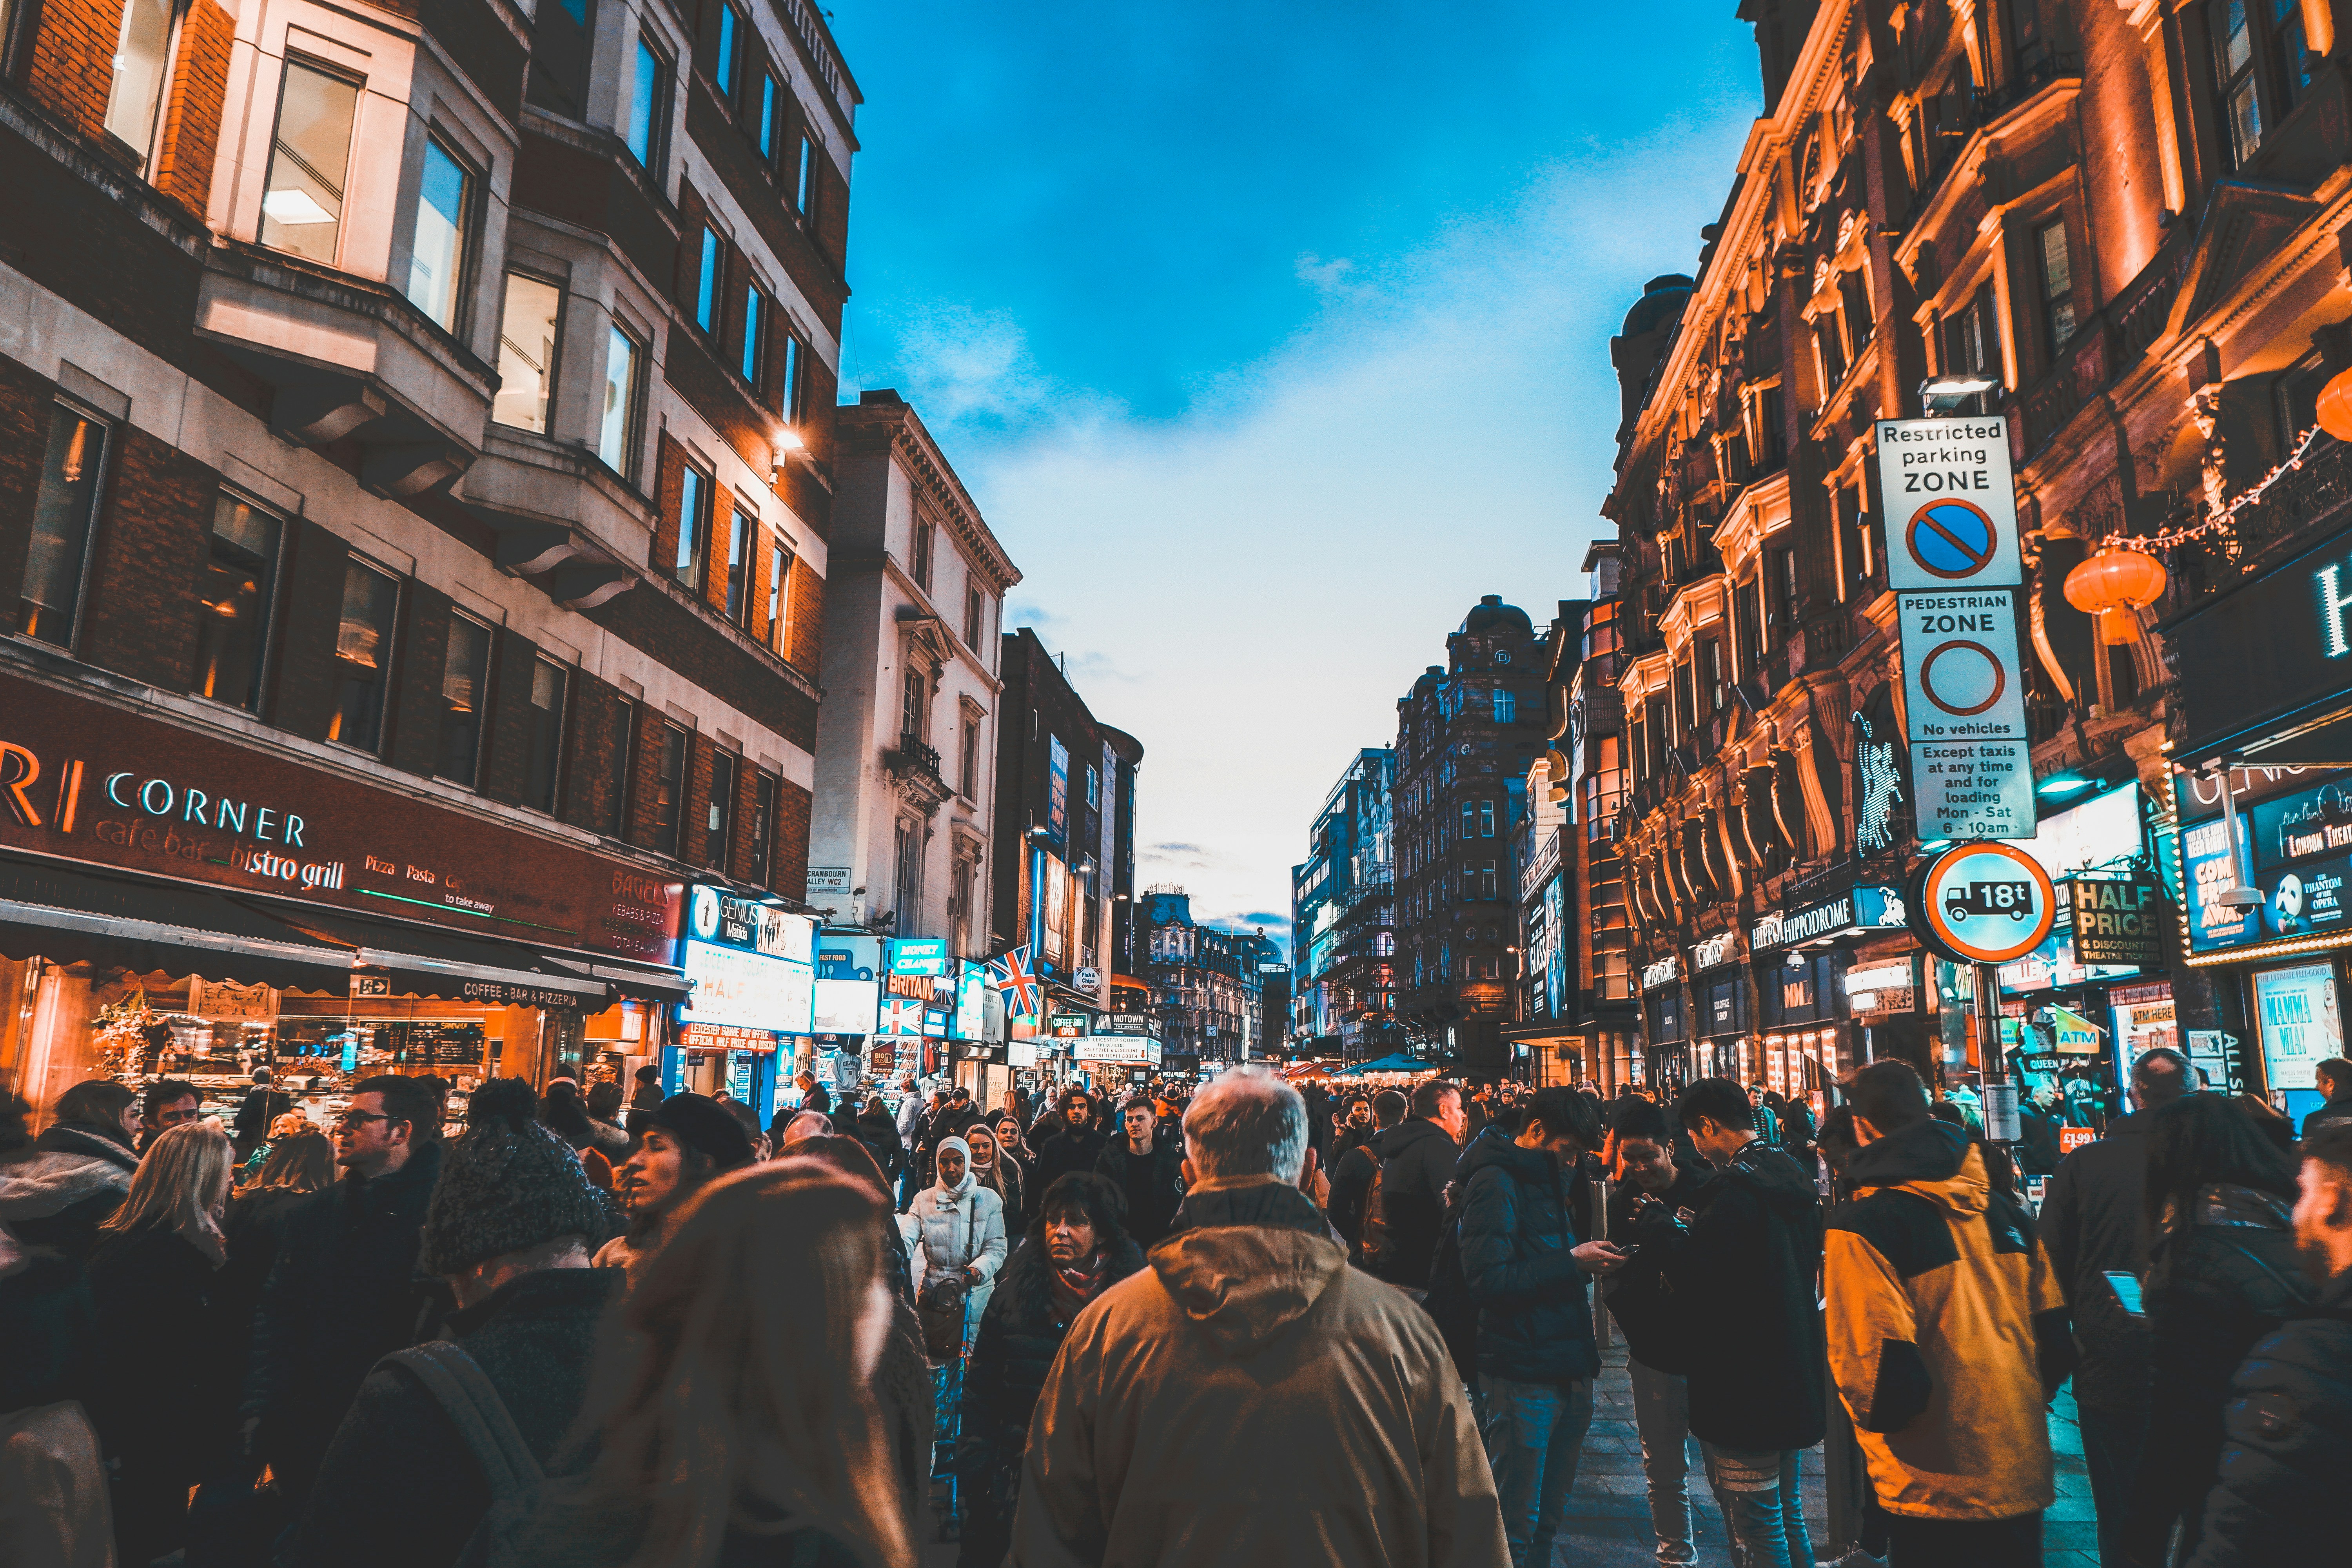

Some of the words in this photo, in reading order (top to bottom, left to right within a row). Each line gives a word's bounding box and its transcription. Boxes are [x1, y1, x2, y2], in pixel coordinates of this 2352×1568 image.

[1884, 422, 2001, 443] Restricted
[1903, 447, 1986, 467] parking
[1904, 470, 1989, 492] ZONE
[1906, 596, 2006, 610] PEDESTRIAN
[1922, 614, 1995, 633] ZONE
[1924, 724, 1947, 735] No
[1949, 723, 2011, 734] vehicles
[1924, 747, 1975, 760] Except
[1979, 746, 2016, 757] taxis
[1928, 763, 1943, 773] at
[1948, 764, 1974, 775] any
[1980, 761, 2013, 771] time
[1945, 777, 1971, 788] and
[1978, 776, 1999, 787] for
[1946, 791, 2000, 804] loading
[106, 772, 305, 848] CORNER
[1937, 807, 1968, 818] Mon
[1986, 806, 2011, 817] Sat
[1943, 822, 1953, 833] 6
[1970, 822, 2009, 833] 10am
[2288, 832, 2324, 857] LONDON
[231, 840, 297, 880] bistro
[300, 860, 345, 891] grill
[365, 855, 395, 875] Pizza
[407, 864, 435, 884] Pasta
[2196, 856, 2234, 884] COM
[613, 871, 670, 909] BAGELS
[2305, 877, 2343, 893] PHANTOM
[445, 894, 454, 904] to
[456, 897, 473, 909] take
[474, 901, 494, 914] away
[1980, 883, 2025, 908] 18t
[2078, 883, 2152, 910] HALF
[2312, 896, 2339, 909] OPERA
[613, 903, 639, 919] KEBABS
[640, 909, 644, 920] &
[646, 911, 664, 924] PIZZA
[720, 896, 758, 926] GENIUS
[1784, 898, 1850, 943] HIPPODROME
[726, 921, 748, 940] Matilda
[2080, 912, 2157, 935] PRICE
[612, 936, 621, 948] TO
[900, 945, 939, 956] MONEY
[2082, 939, 2090, 949] &
[1530, 936, 1546, 977] GLASS
[1698, 944, 1722, 969] CASINO
[2082, 951, 2123, 960] THEATRE
[1644, 962, 1676, 989] HIPPODROME
[465, 982, 501, 998] COFFEE
[510, 987, 528, 1001] BAR
[531, 990, 536, 1002] &
[539, 991, 577, 1007] PIZZERIA
[889, 974, 935, 1001] BRITAIN
[988, 994, 998, 1004] BOTTLE
[1114, 1015, 1143, 1023] MOTOWN
[2134, 1010, 2150, 1022] ATM
[2152, 1007, 2172, 1020] HERE
[2266, 994, 2312, 1025] MAMMA
[690, 1023, 720, 1035] LEICESTER
[722, 1026, 740, 1037] SQUARE
[740, 1028, 751, 1038] BOX
[752, 1029, 769, 1040] OFFICE
[1053, 1018, 1072, 1027] COFFEE
[1073, 1018, 1083, 1027] BAR
[1061, 1027, 1075, 1036] OPEN
[689, 1034, 714, 1046] OFFICIAL
[716, 1036, 730, 1047] HALF
[731, 1038, 746, 1048] PRICE
[2060, 1031, 2096, 1044] ATM
[2279, 1025, 2307, 1055] MIA!
[2224, 1033, 2241, 1073] ALL
[2030, 1060, 2058, 1070] QUEEN
[2064, 1132, 2091, 1148] £1.99
